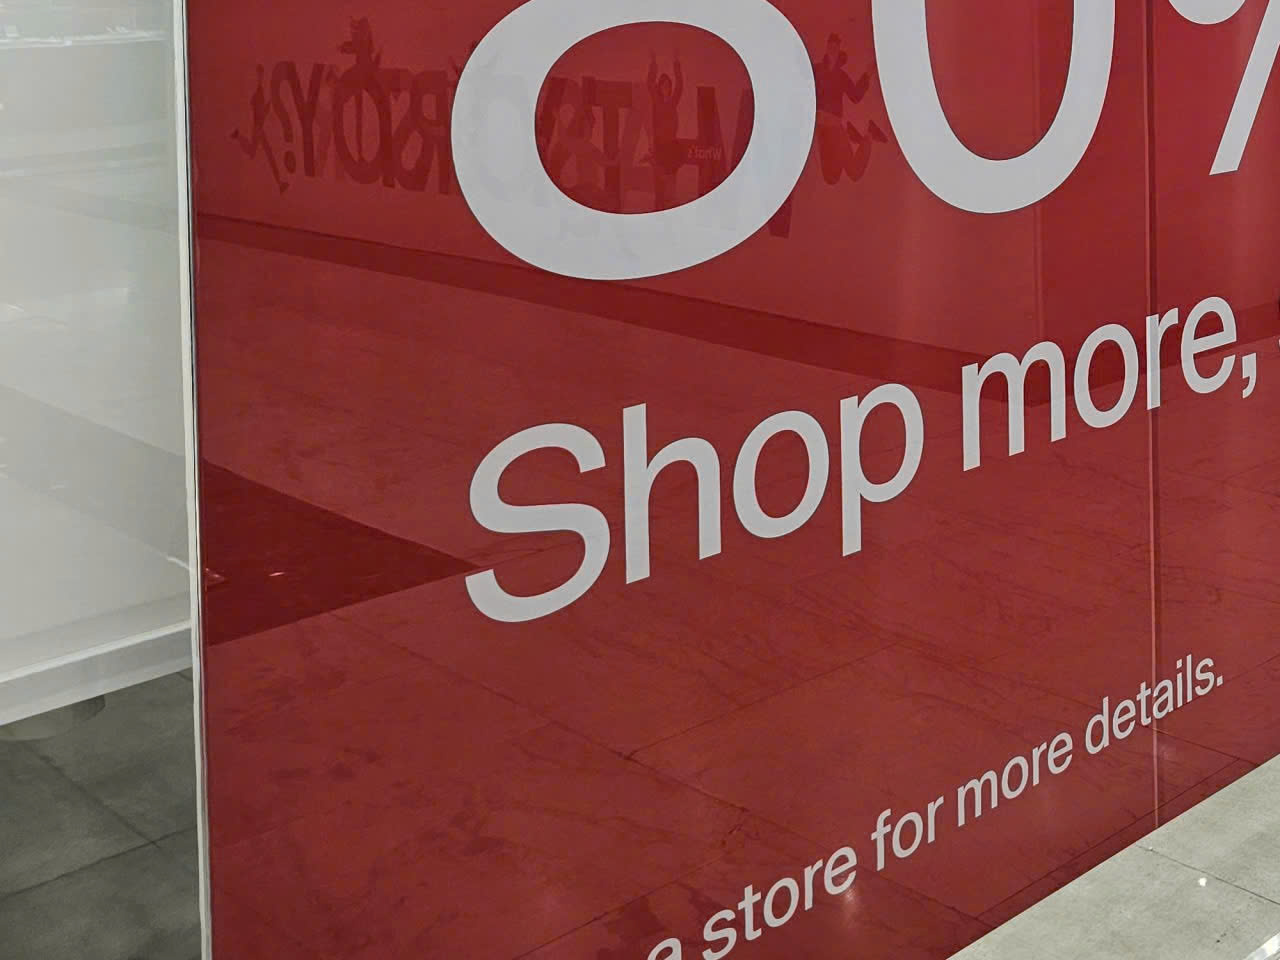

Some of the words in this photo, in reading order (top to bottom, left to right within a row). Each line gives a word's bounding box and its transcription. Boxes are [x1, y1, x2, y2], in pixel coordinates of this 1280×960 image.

[465, 403, 924, 623] Shop
[961, 296, 1257, 471] more,
[701, 846, 859, 960] store
[869, 795, 946, 872] for
[955, 729, 1074, 827] more
[1084, 652, 1225, 756] details.
